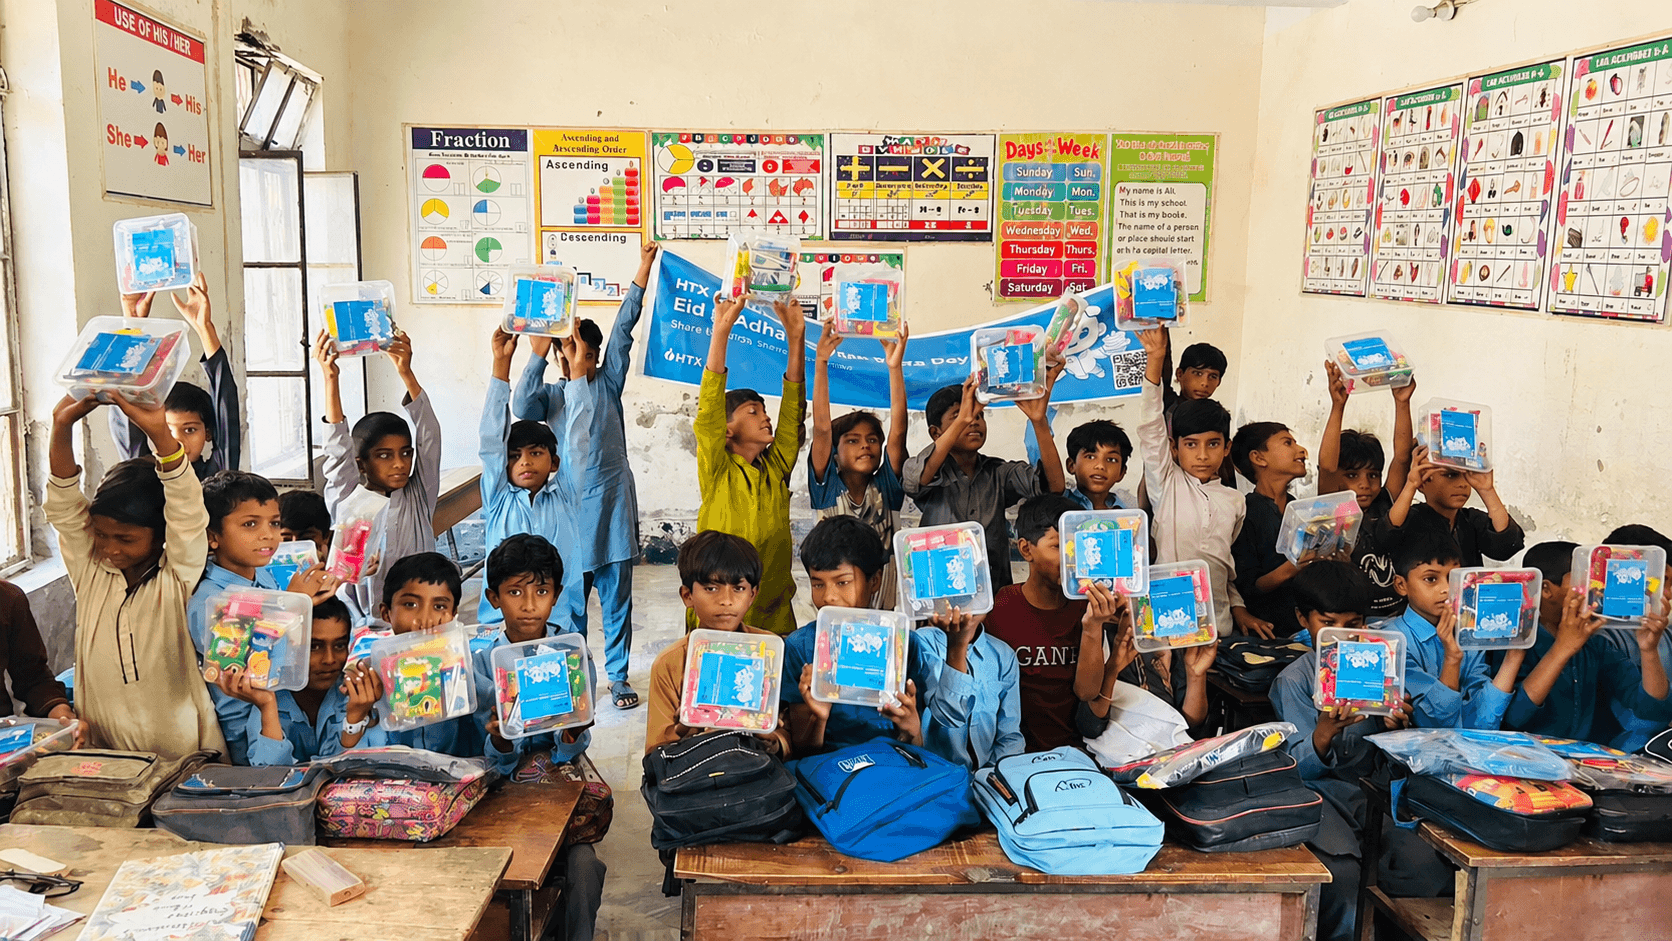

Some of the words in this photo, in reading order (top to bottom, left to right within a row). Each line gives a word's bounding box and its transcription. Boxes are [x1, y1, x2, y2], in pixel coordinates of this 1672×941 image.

[114, 6, 136, 32] USE
[138, 19, 151, 38] OF
[153, 24, 168, 46] HIS
[108, 67, 126, 91] He
[185, 94, 202, 115] His
[107, 124, 132, 148] She
[430, 130, 511, 148] Fraction
[188, 144, 206, 164] Her
[1005, 141, 1043, 160] Days
[1057, 137, 1100, 159] Week
[546, 159, 609, 172] Ascending
[1016, 167, 1053, 179] Sunday
[1074, 168, 1096, 178] Sun.
[1014, 186, 1054, 198] Monday
[1071, 187, 1095, 197] Mon.
[1119, 186, 1131, 196] My
[1147, 200, 1159, 208] my
[1012, 205, 1053, 218] Tuesday
[1069, 205, 1095, 216] Tues.
[1147, 212, 1160, 220] my
[1006, 225, 1061, 237] Wednesday
[1070, 225, 1093, 236] Wed.
[1010, 244, 1055, 256] Thursday
[1066, 244, 1095, 255] Thurs.
[1017, 263, 1048, 276] Friday
[1071, 263, 1088, 274] Fri.
[676, 278, 710, 297] HTX
[1008, 282, 1053, 294] Saturday
[674, 297, 706, 317] Eid
[733, 314, 786, 341] Adha
[671, 319, 702, 334] Share
[675, 353, 702, 367] HTX
[930, 356, 968, 365] Day
